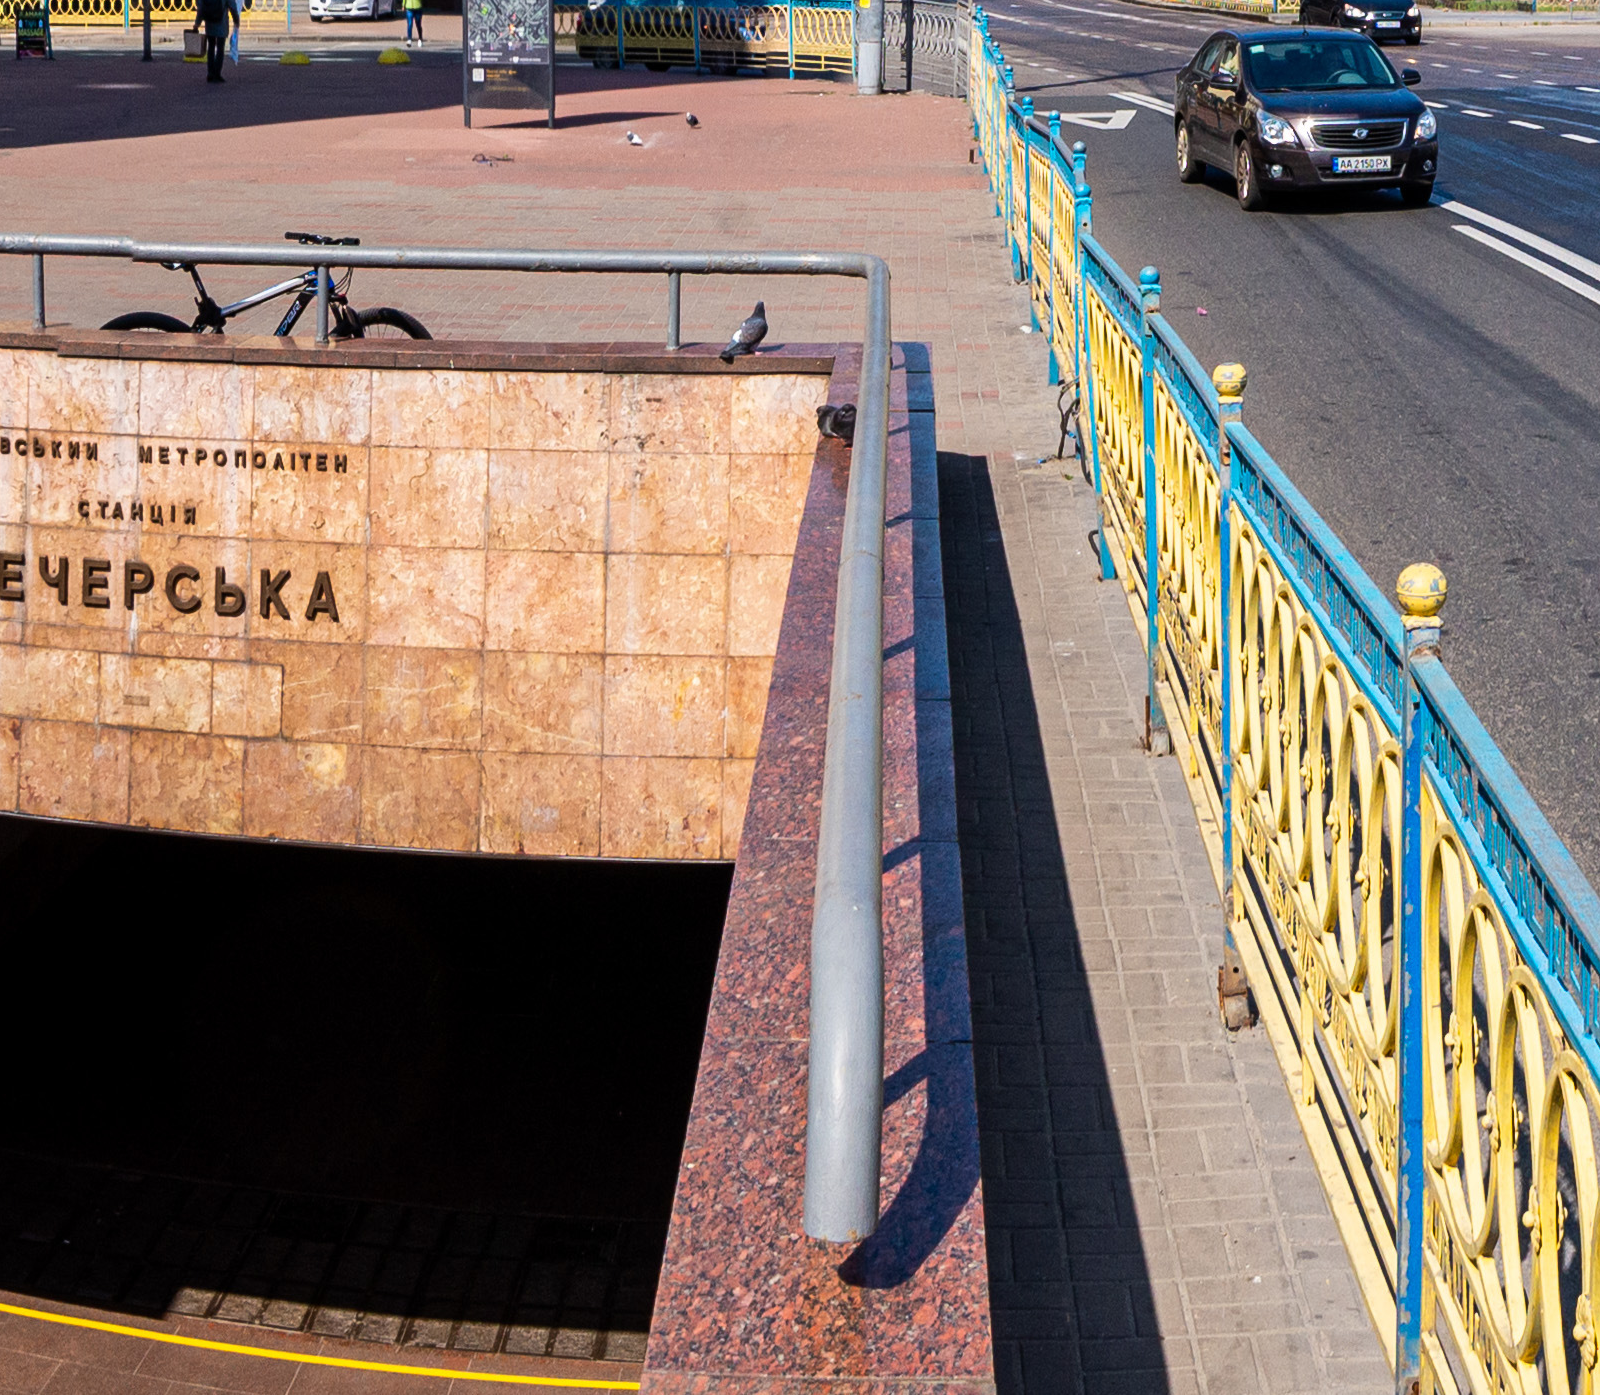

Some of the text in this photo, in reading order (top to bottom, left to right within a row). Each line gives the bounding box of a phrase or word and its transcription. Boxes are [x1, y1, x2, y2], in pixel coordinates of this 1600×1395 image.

[1340, 159, 1353, 169] AA
[138, 445, 348, 474] МЕТРОПОЛІТЕН
[78, 500, 197, 526] СТАНЦІЯ
